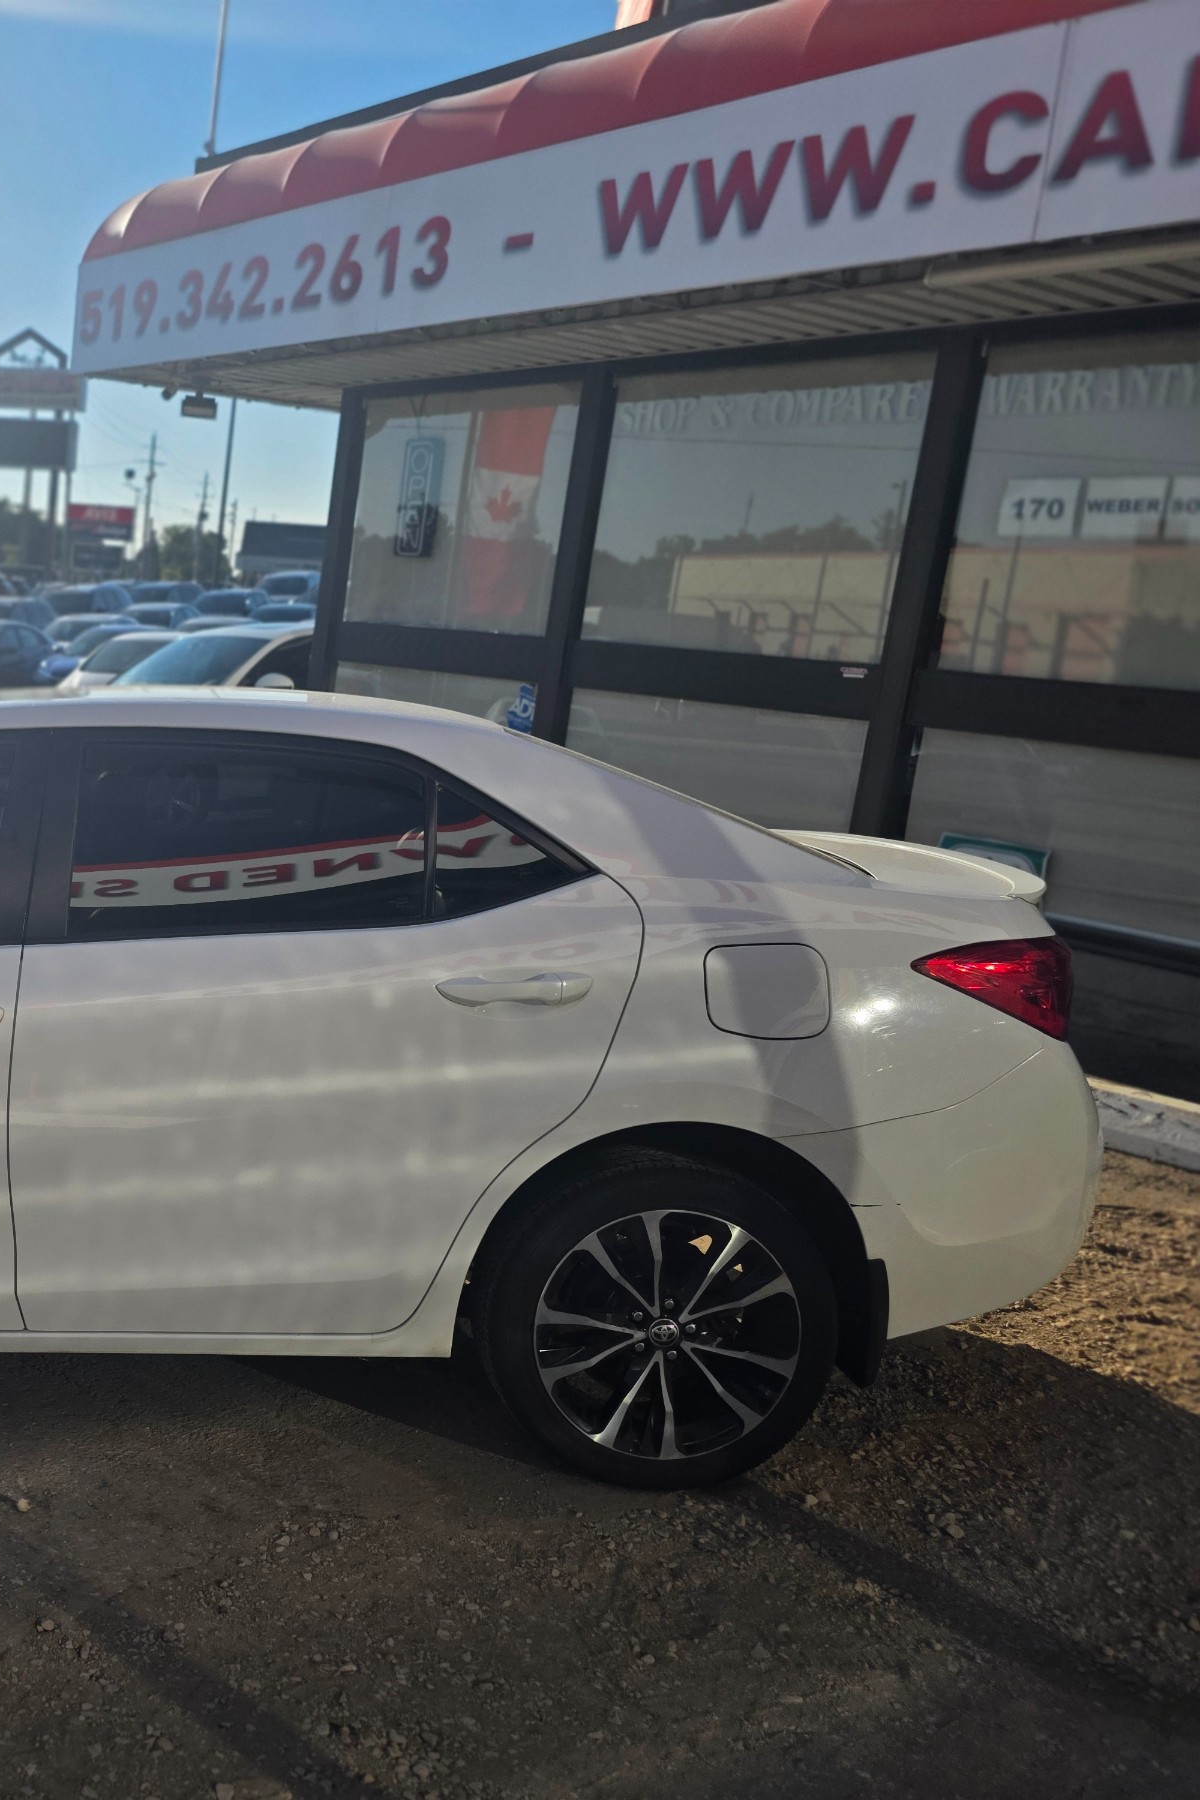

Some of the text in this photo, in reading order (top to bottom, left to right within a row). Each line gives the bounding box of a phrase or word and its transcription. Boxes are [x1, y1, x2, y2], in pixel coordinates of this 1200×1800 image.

[80, 214, 452, 344] 519.342.2613
[616, 396, 696, 433] SHOP
[749, 381, 926, 427] COMPARE
[402, 447, 430, 549] OPEN
[1011, 498, 1065, 521] 170
[1087, 497, 1160, 514] WEBER
